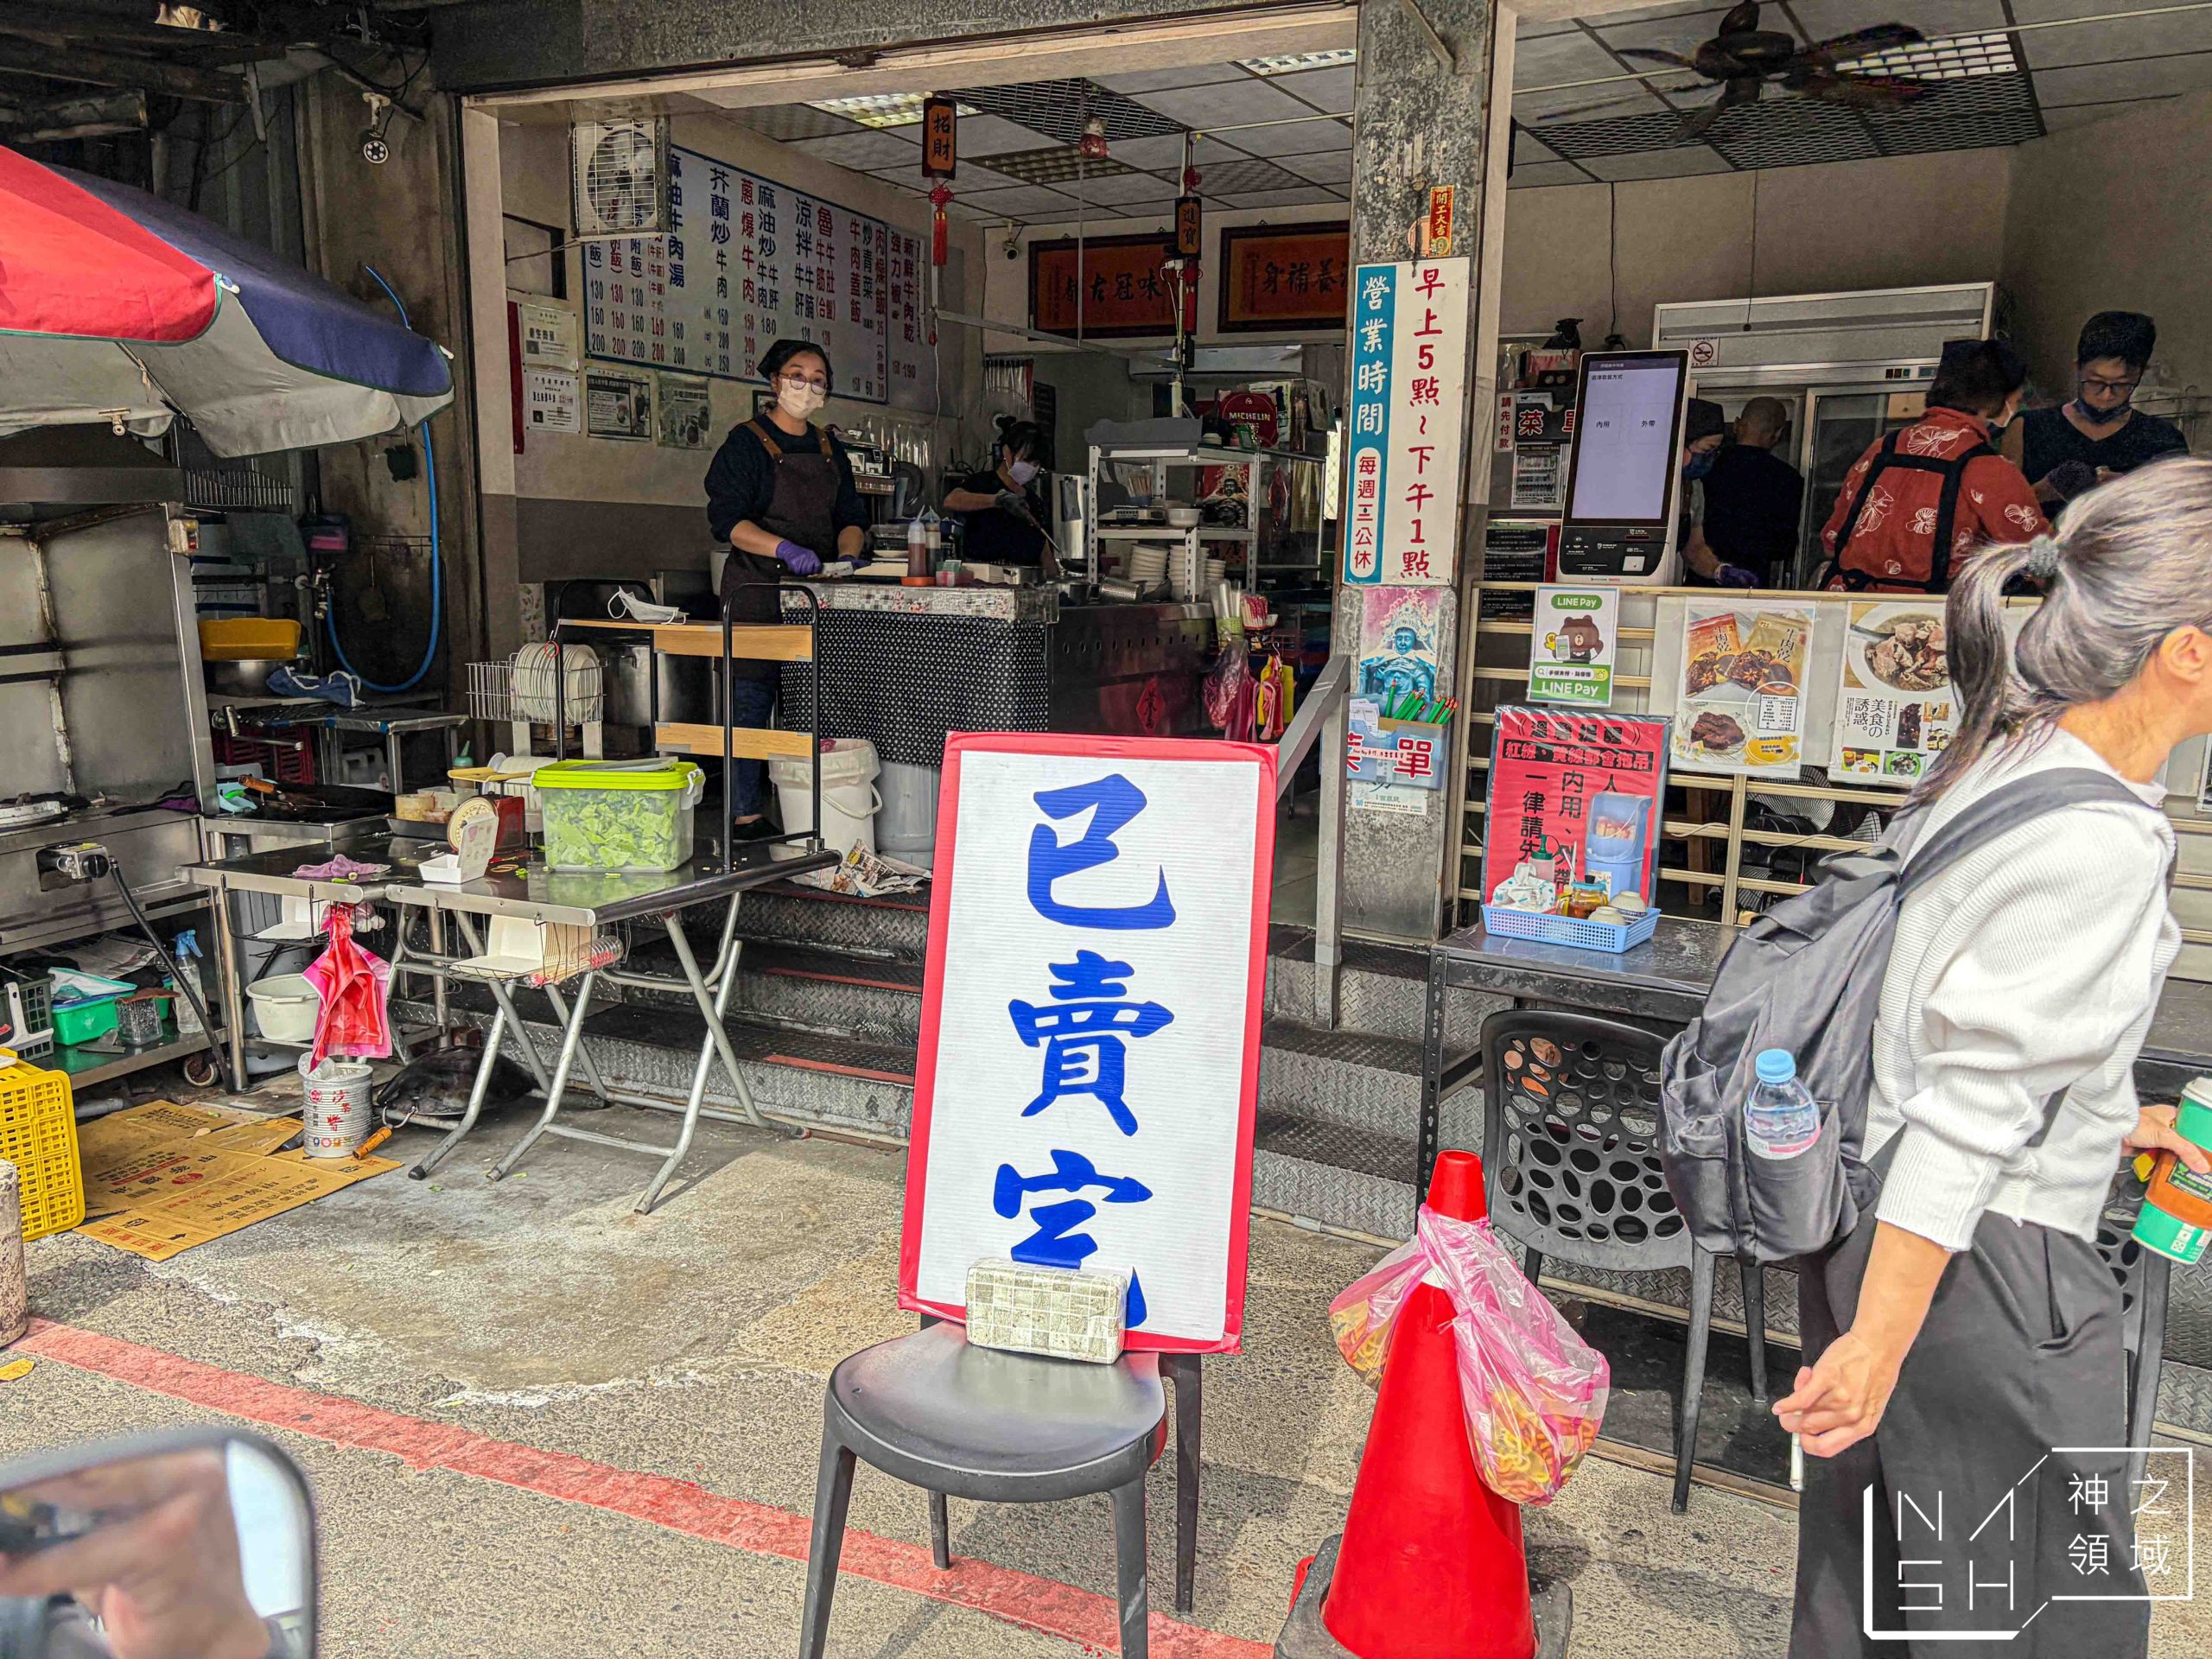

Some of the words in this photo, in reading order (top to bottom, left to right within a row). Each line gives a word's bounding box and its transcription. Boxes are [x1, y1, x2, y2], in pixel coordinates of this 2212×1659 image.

[932, 113, 950, 162] 招財
[758, 185, 776, 257] 麻油炒
[817, 207, 832, 238] 魯
[1435, 193, 1447, 236] 開工大吉
[796, 197, 812, 258] 涼拌
[1184, 207, 1196, 246] 進寶
[850, 218, 861, 323] 牛肉蓋飯
[862, 222, 873, 300] 炒青菜
[590, 279, 604, 301] 130
[610, 283, 624, 304] 130
[631, 288, 644, 308] 130
[591, 305, 605, 326] 160
[610, 310, 625, 331] 160
[631, 314, 645, 334] 160
[761, 317, 776, 335] 180
[652, 317, 664, 337] 160
[673, 321, 683, 340] 160
[591, 333, 605, 353] 200
[612, 337, 626, 356] 200
[632, 340, 645, 359] 200
[652, 343, 664, 362] 200
[673, 346, 684, 366] 200
[1357, 276, 1390, 436] 營業時間
[902, 363, 916, 380] 190
[1229, 411, 1271, 423] MICHELIN
[1500, 397, 1512, 448] 請先付款
[1354, 456, 1376, 569] 每週三公休
[1557, 597, 1579, 607] LINE
[1580, 597, 1597, 608] Pay
[1541, 681, 1573, 694] LINE
[1574, 683, 1599, 697] Pay
[1869, 698, 1885, 738] 美食の
[993, 773, 1176, 1329] 已賣完
